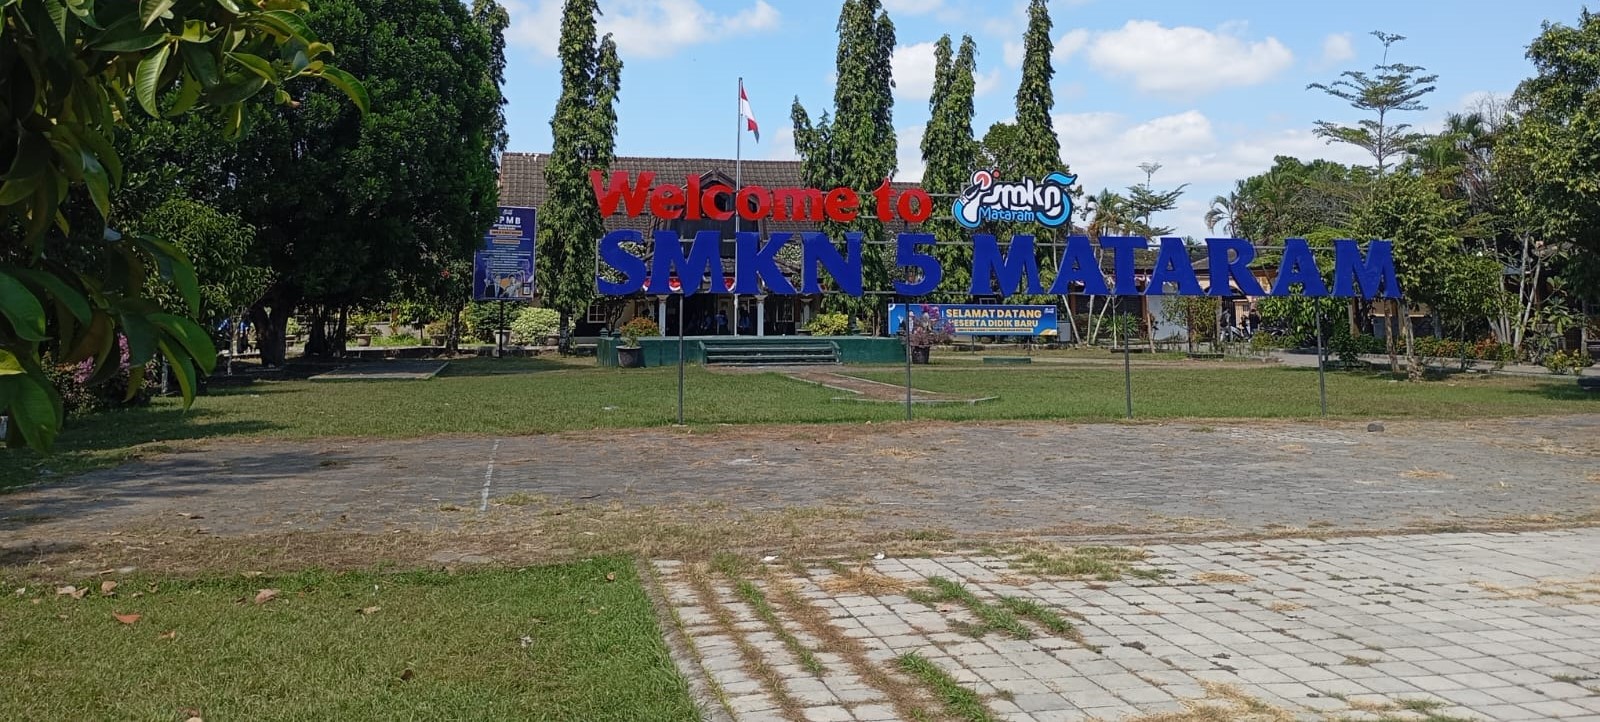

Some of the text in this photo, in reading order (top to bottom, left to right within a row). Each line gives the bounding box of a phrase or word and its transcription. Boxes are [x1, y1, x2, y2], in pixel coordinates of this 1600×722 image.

[589, 170, 932, 222] Welcome to
[979, 207, 1035, 221] Mataram
[598, 230, 864, 298] SMKN
[895, 235, 942, 297] 5
[970, 234, 1402, 300] MATARAM
[946, 309, 995, 318] SELAMAT
[997, 309, 1042, 318] DATANG
[988, 319, 1013, 327] DIDIK
[1014, 319, 1038, 327] BARU
